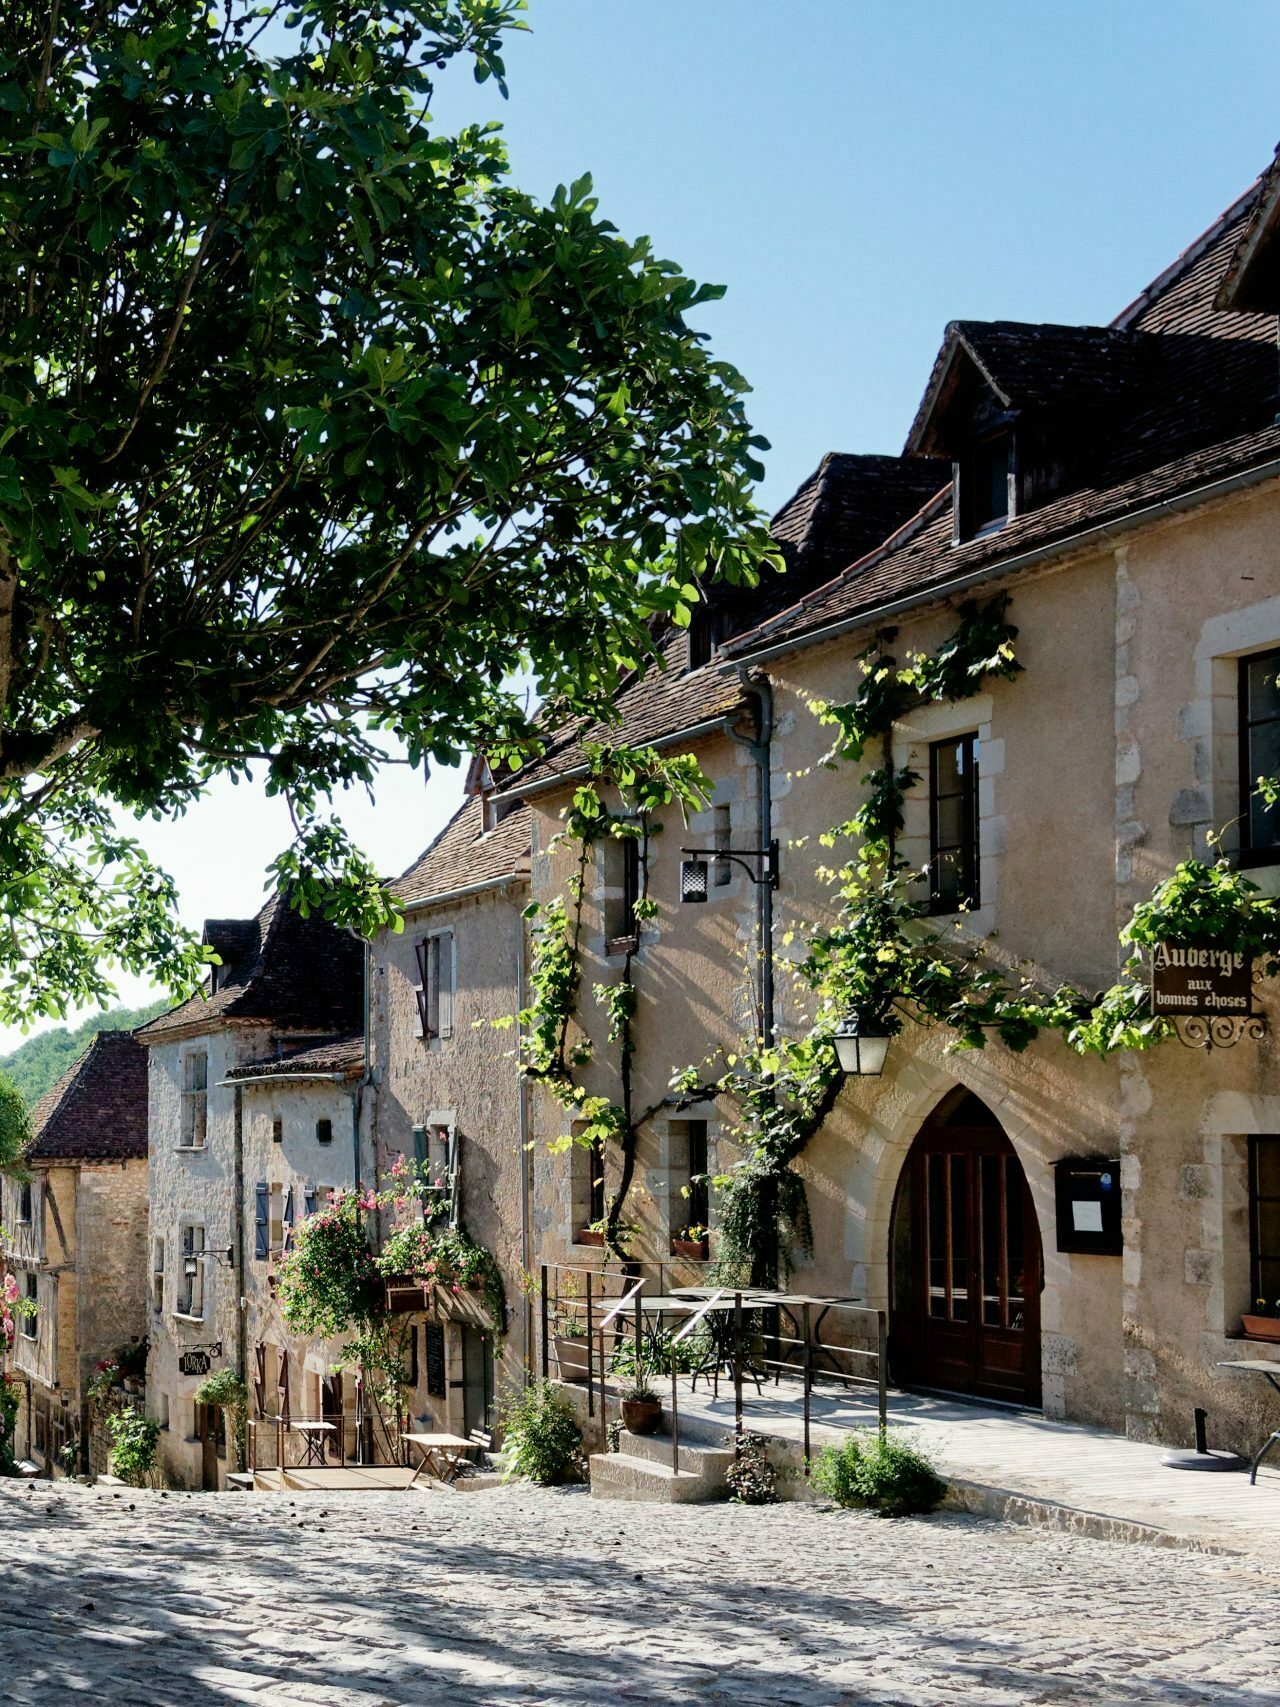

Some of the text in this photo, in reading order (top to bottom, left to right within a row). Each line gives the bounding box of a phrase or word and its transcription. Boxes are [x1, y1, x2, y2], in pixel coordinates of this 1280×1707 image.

[1187, 979, 1212, 990] aux
[1156, 990, 1247, 1009] bonnes choses
[184, 1353, 208, 1373] LORKA
